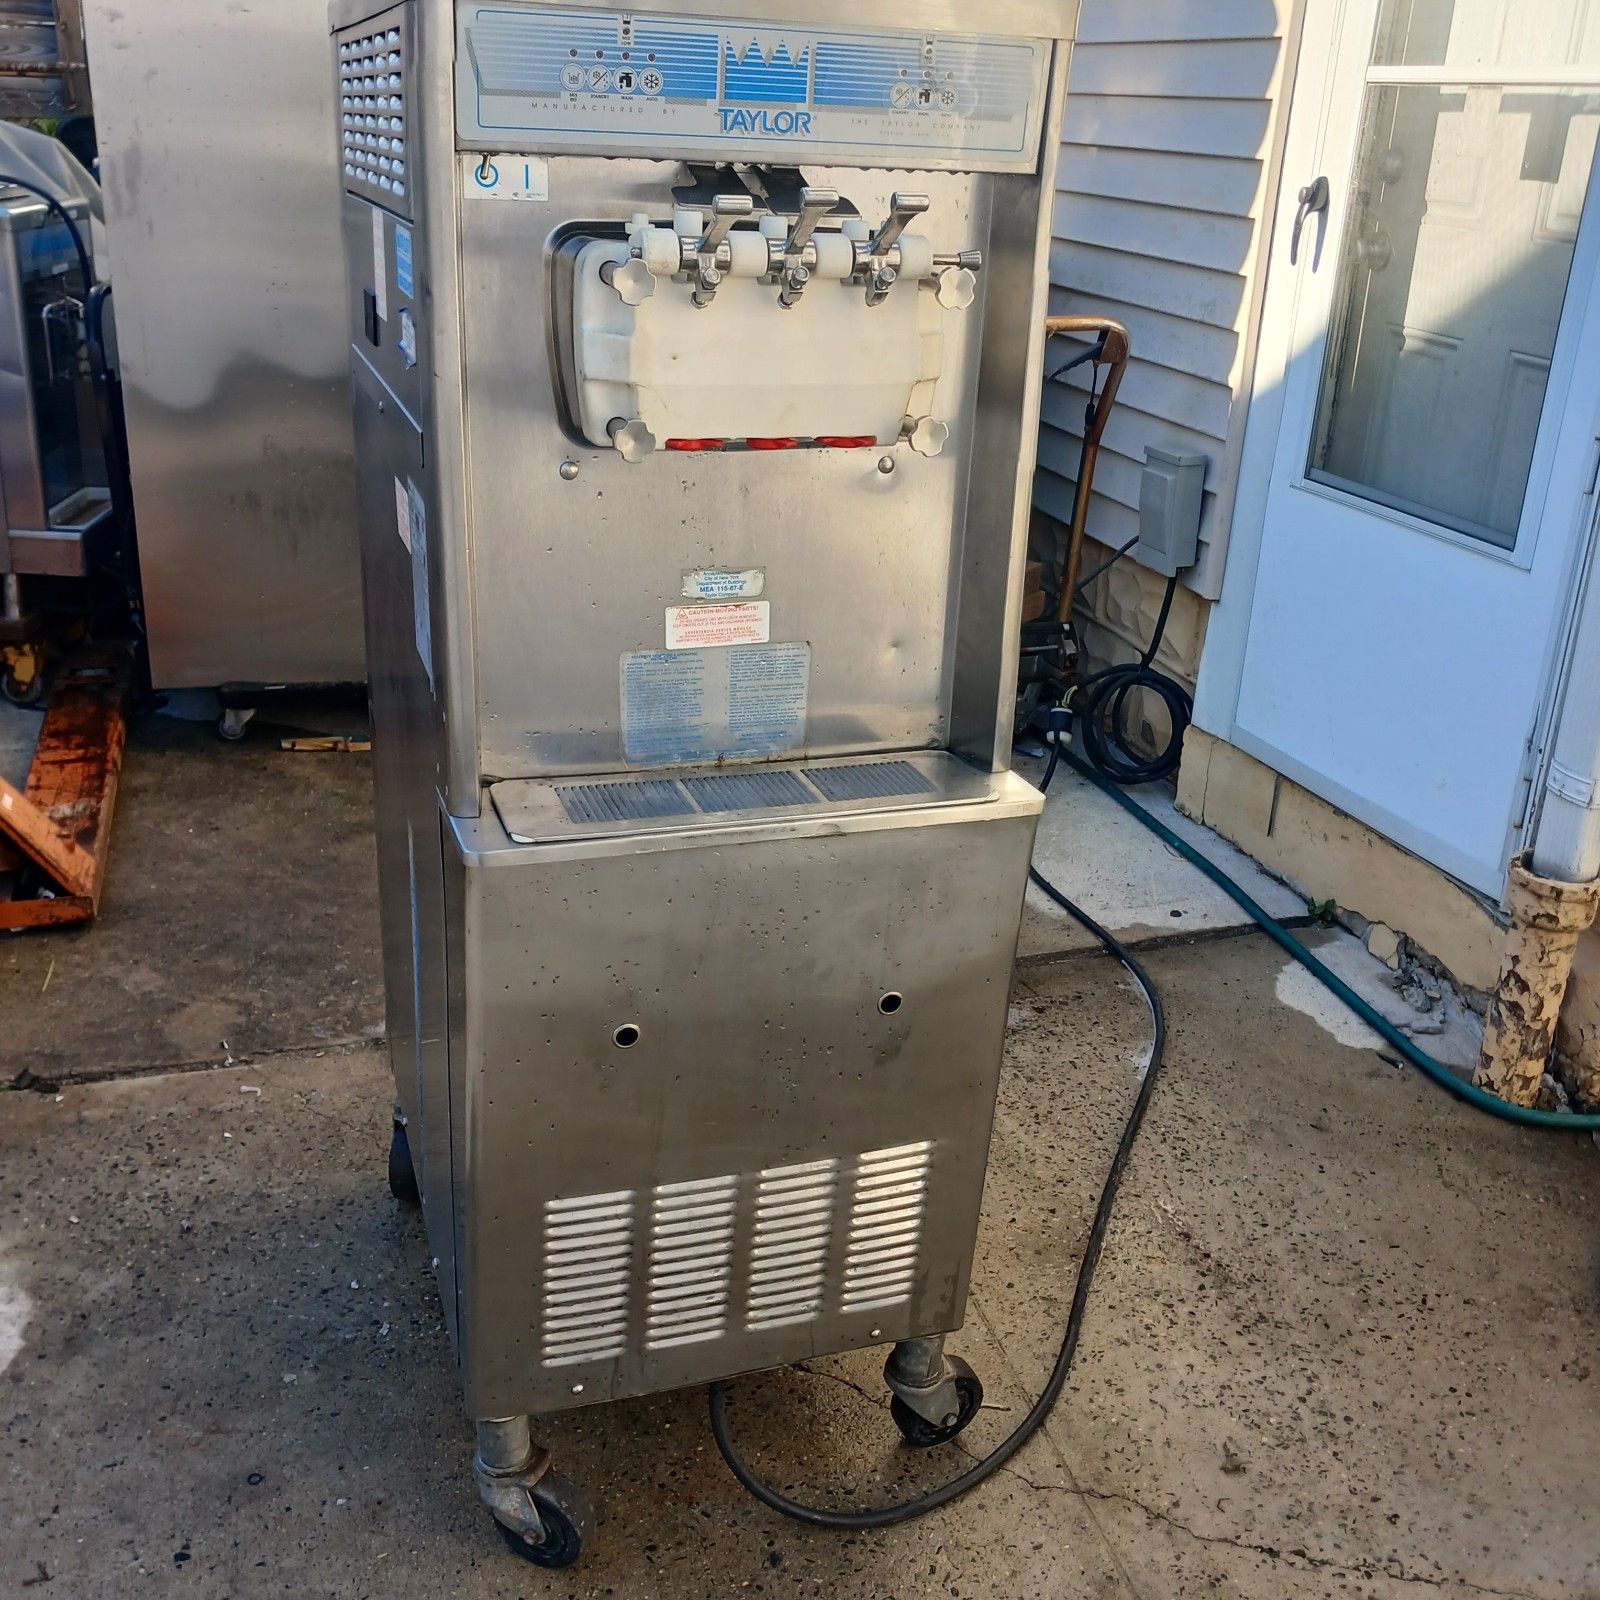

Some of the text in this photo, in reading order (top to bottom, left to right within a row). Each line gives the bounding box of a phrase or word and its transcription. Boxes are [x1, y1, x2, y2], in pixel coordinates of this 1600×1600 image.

[531, 102, 643, 113] MANUFACTURED
[881, 120, 920, 128] TAYLOR
[933, 123, 981, 131] COMPANY
